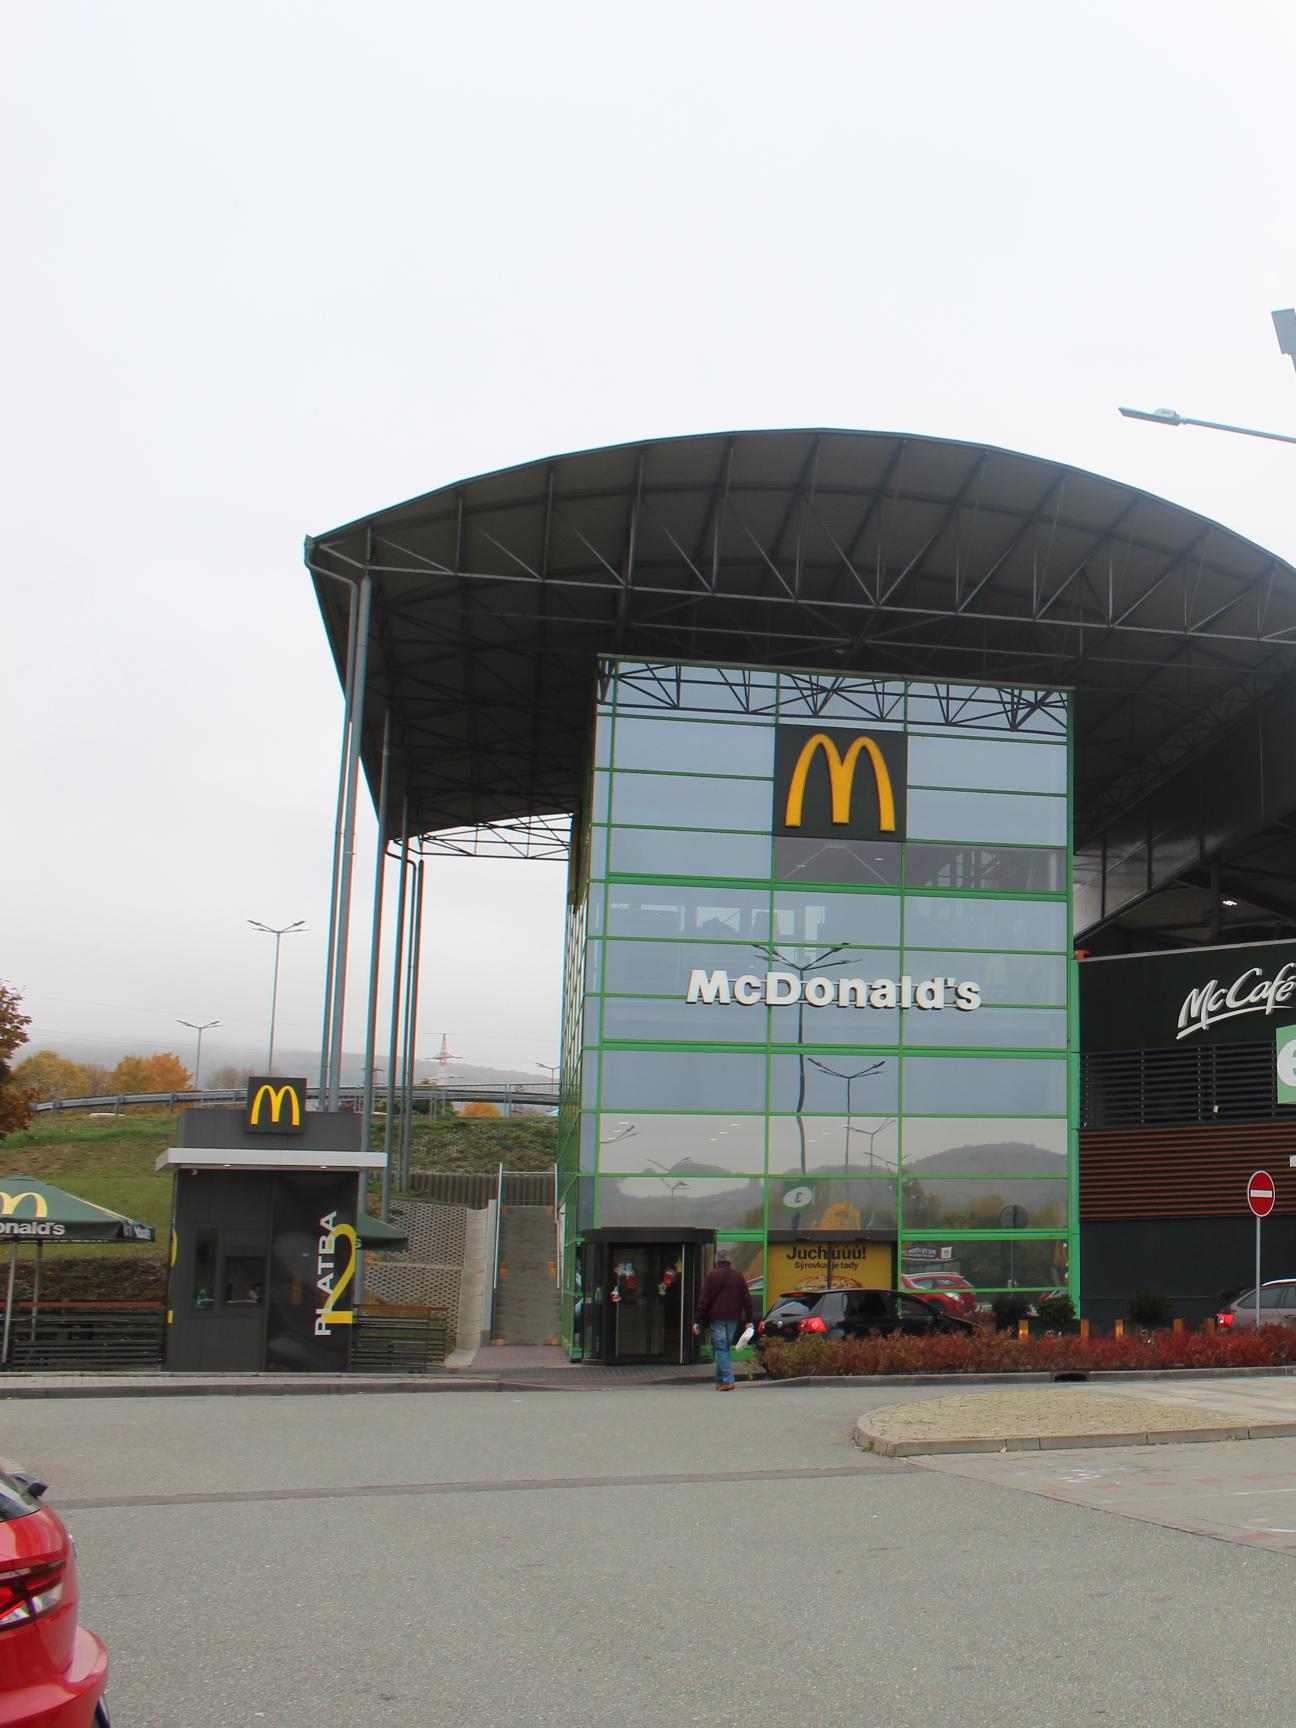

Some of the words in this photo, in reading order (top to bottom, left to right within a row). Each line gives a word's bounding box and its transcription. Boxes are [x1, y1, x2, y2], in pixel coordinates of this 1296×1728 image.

[686, 969, 982, 1011] McDonald's
[315, 1210, 337, 1336] PLATBA
[320, 1223, 357, 1324] 2
[831, 1261, 840, 1271] je
[841, 1261, 859, 1271] tady
